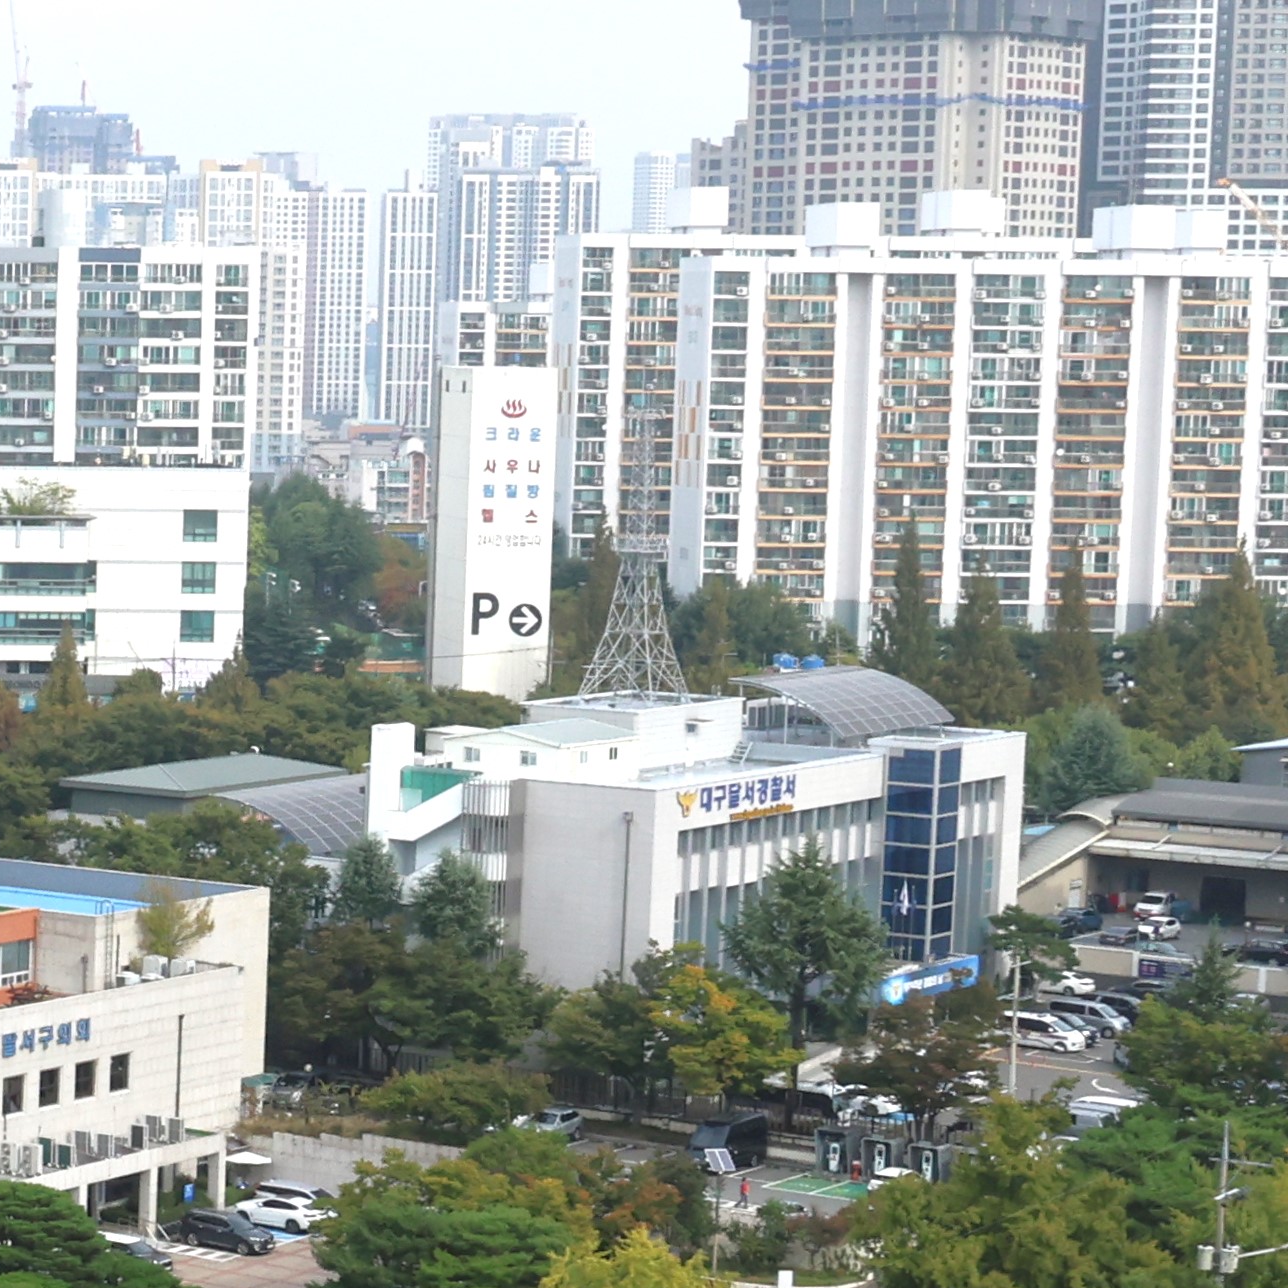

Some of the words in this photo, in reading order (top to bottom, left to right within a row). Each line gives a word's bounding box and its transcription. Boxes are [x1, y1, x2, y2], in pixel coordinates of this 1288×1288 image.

[485, 427, 541, 442] 크라운
[484, 459, 540, 474] 사우나
[471, 592, 500, 636] P
[699, 773, 798, 814] 대구달서경찰서
